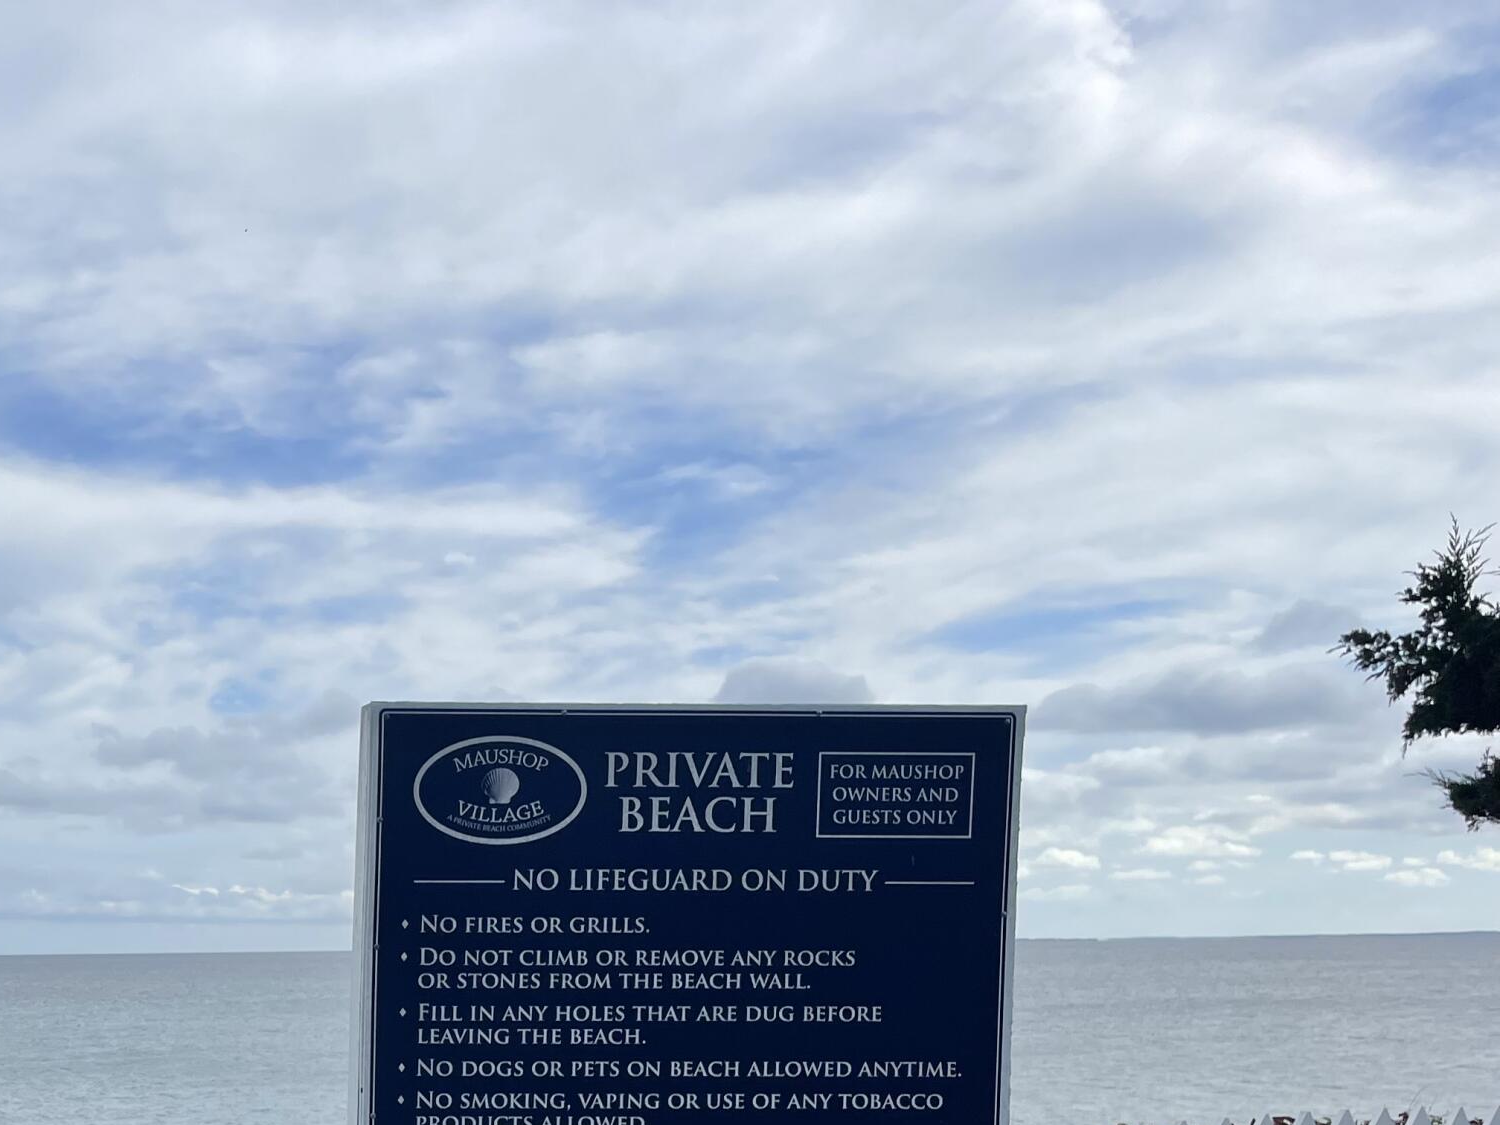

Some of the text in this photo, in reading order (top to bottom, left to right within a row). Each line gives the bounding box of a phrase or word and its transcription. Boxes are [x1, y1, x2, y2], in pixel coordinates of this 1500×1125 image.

[453, 749, 549, 773] MAUSHOP
[604, 751, 794, 789] PRIVATE
[830, 763, 965, 780] FOR MAUSHOP
[832, 786, 959, 802] OWNERS AND
[458, 800, 545, 823] VILLAGE
[618, 795, 777, 833] BEACH
[832, 809, 957, 825] GUESTS ONLY
[453, 816, 481, 830] PRIVATE
[482, 824, 506, 833] BEACH
[506, 813, 552, 832] COMMUNITY
[513, 868, 879, 892] NO LIFEGUARD ON DUTY
[420, 914, 650, 934] NO FIRES OR GRILLS.
[419, 947, 856, 967] DO NOT CLIMB OR REMOVE ANY ROCKS
[417, 972, 811, 990] OR STONES FROM THE BEACH WALL.
[418, 1002, 882, 1023] FILL IN ANY HOLES THAT ARE DUG BEFORE
[418, 1028, 646, 1045] LEAVING THE BEACH.
[416, 1058, 962, 1078] NO DOGS OR PETS ON BEACH ALLOWED ANYTIME.
[416, 1090, 944, 1111] NO SMOKING, VAPING OR USE OF ANY TOBACCO
